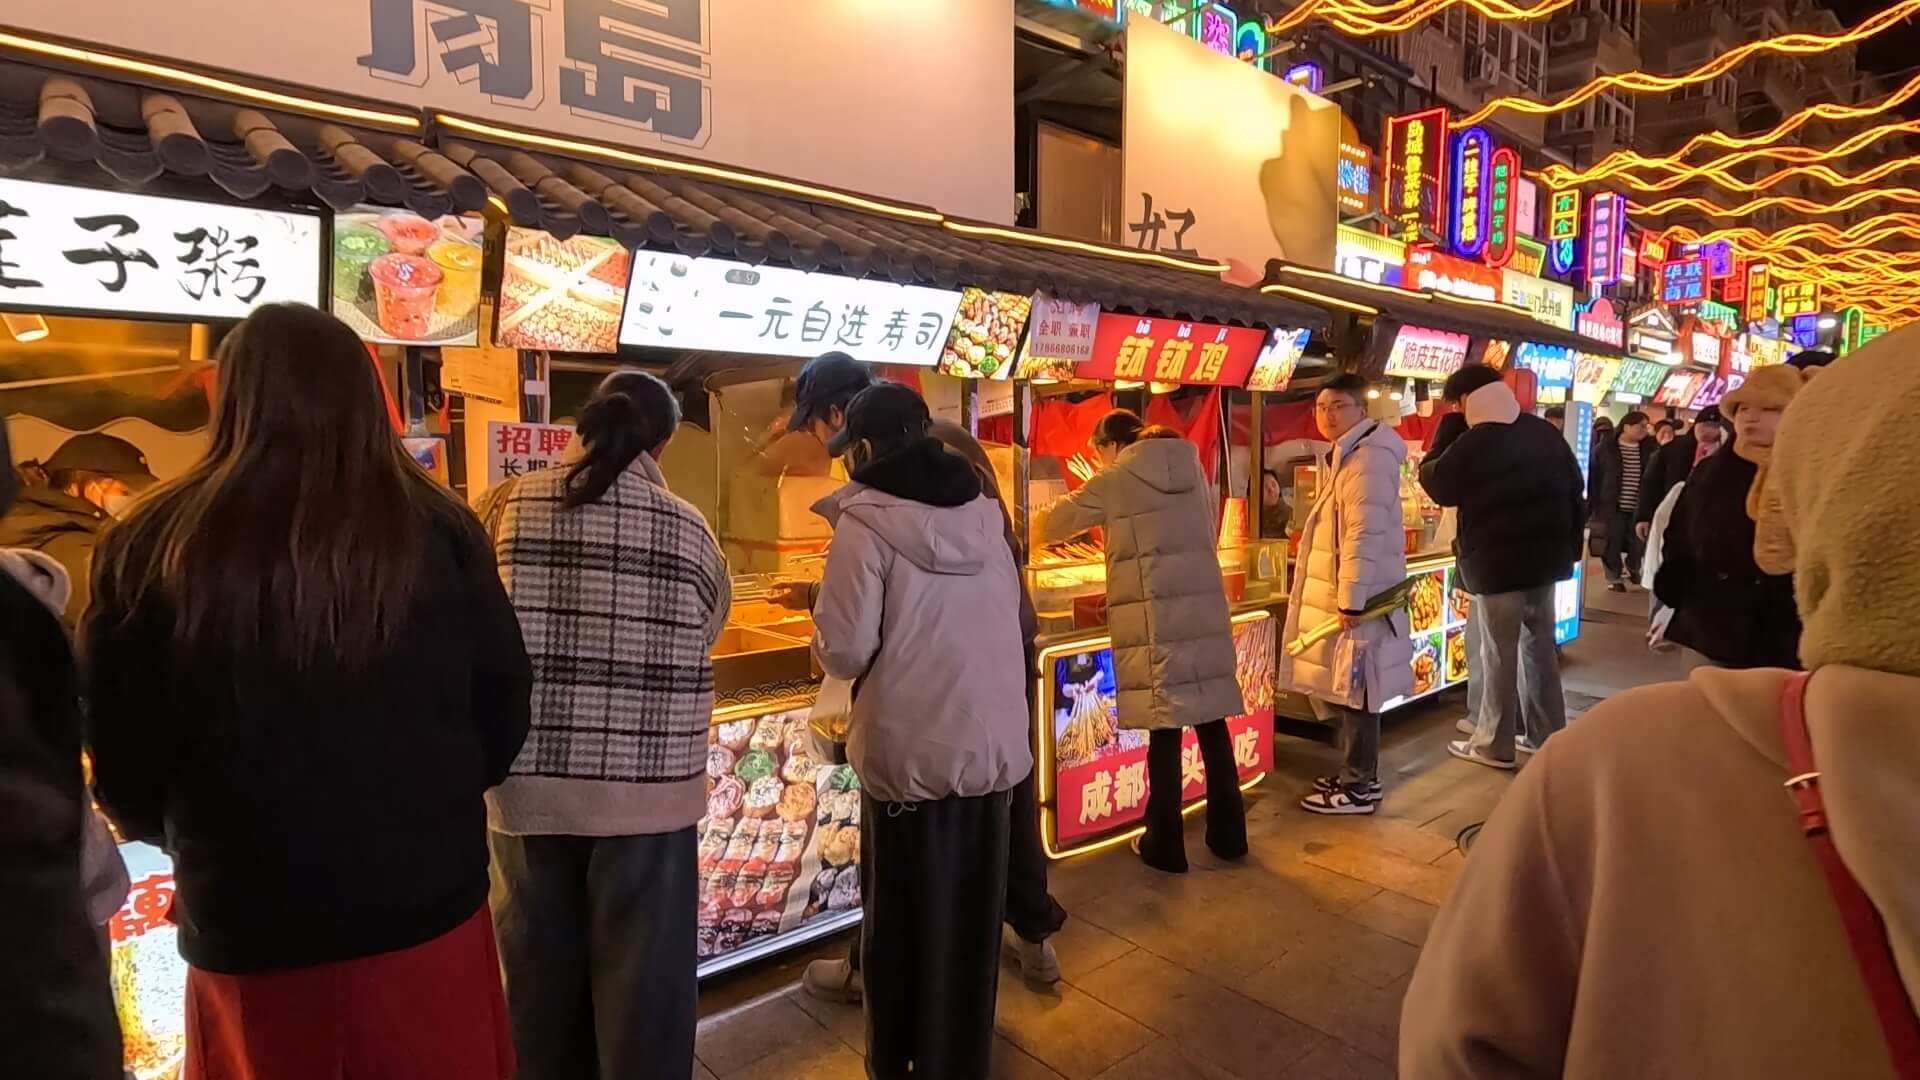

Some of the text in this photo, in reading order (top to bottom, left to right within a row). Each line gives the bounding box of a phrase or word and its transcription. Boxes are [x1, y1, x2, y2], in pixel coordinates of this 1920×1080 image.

[1038, 319, 1062, 337] 全职
[1113, 335, 1230, 382] 钵钵鸡
[496, 425, 572, 455] 招聘
[1080, 727, 1259, 824] 成都头吃
